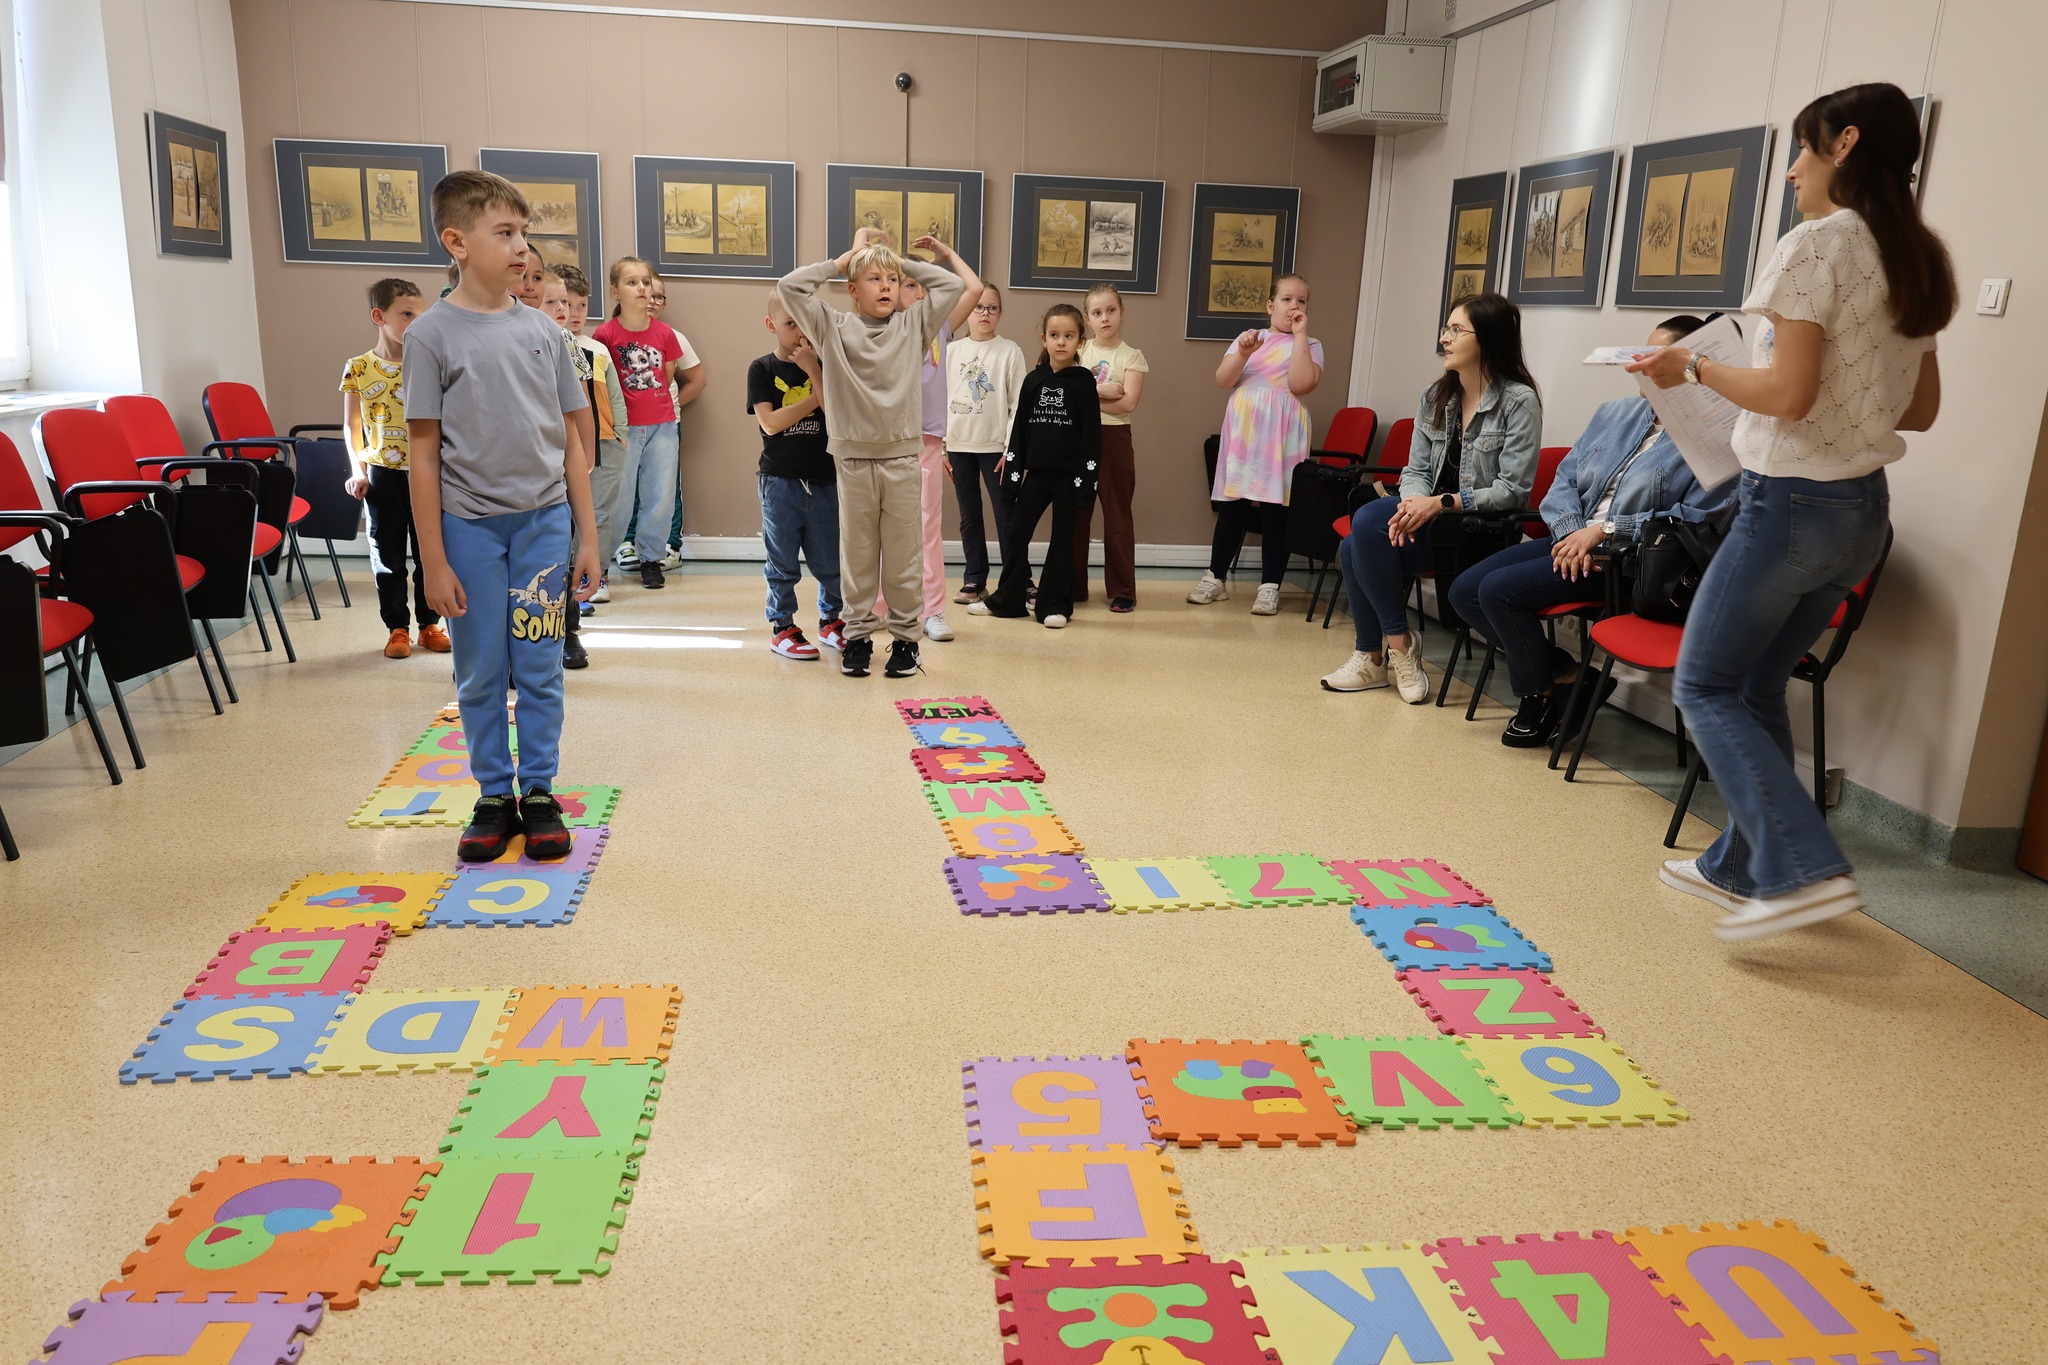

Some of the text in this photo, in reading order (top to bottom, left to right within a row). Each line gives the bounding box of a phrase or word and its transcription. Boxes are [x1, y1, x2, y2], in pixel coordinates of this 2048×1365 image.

[904, 706, 994, 720] META
[972, 822, 1038, 852] 8
[467, 878, 550, 915] C
[1249, 862, 1316, 897] 7
[1358, 867, 1452, 899] N
[235, 939, 345, 986] B
[365, 1000, 480, 1054] D
[1438, 978, 1554, 1025] Z
[183, 1005, 296, 1062] S
[1010, 1071, 1102, 1137] 5
[1370, 1051, 1464, 1107] V
[495, 1076, 601, 1139] Y
[461, 1172, 540, 1255] 1
[1029, 1163, 1147, 1240] F
[1282, 1266, 1454, 1365] K
[1490, 1259, 1610, 1360] 4
[1685, 1245, 1858, 1339] U
